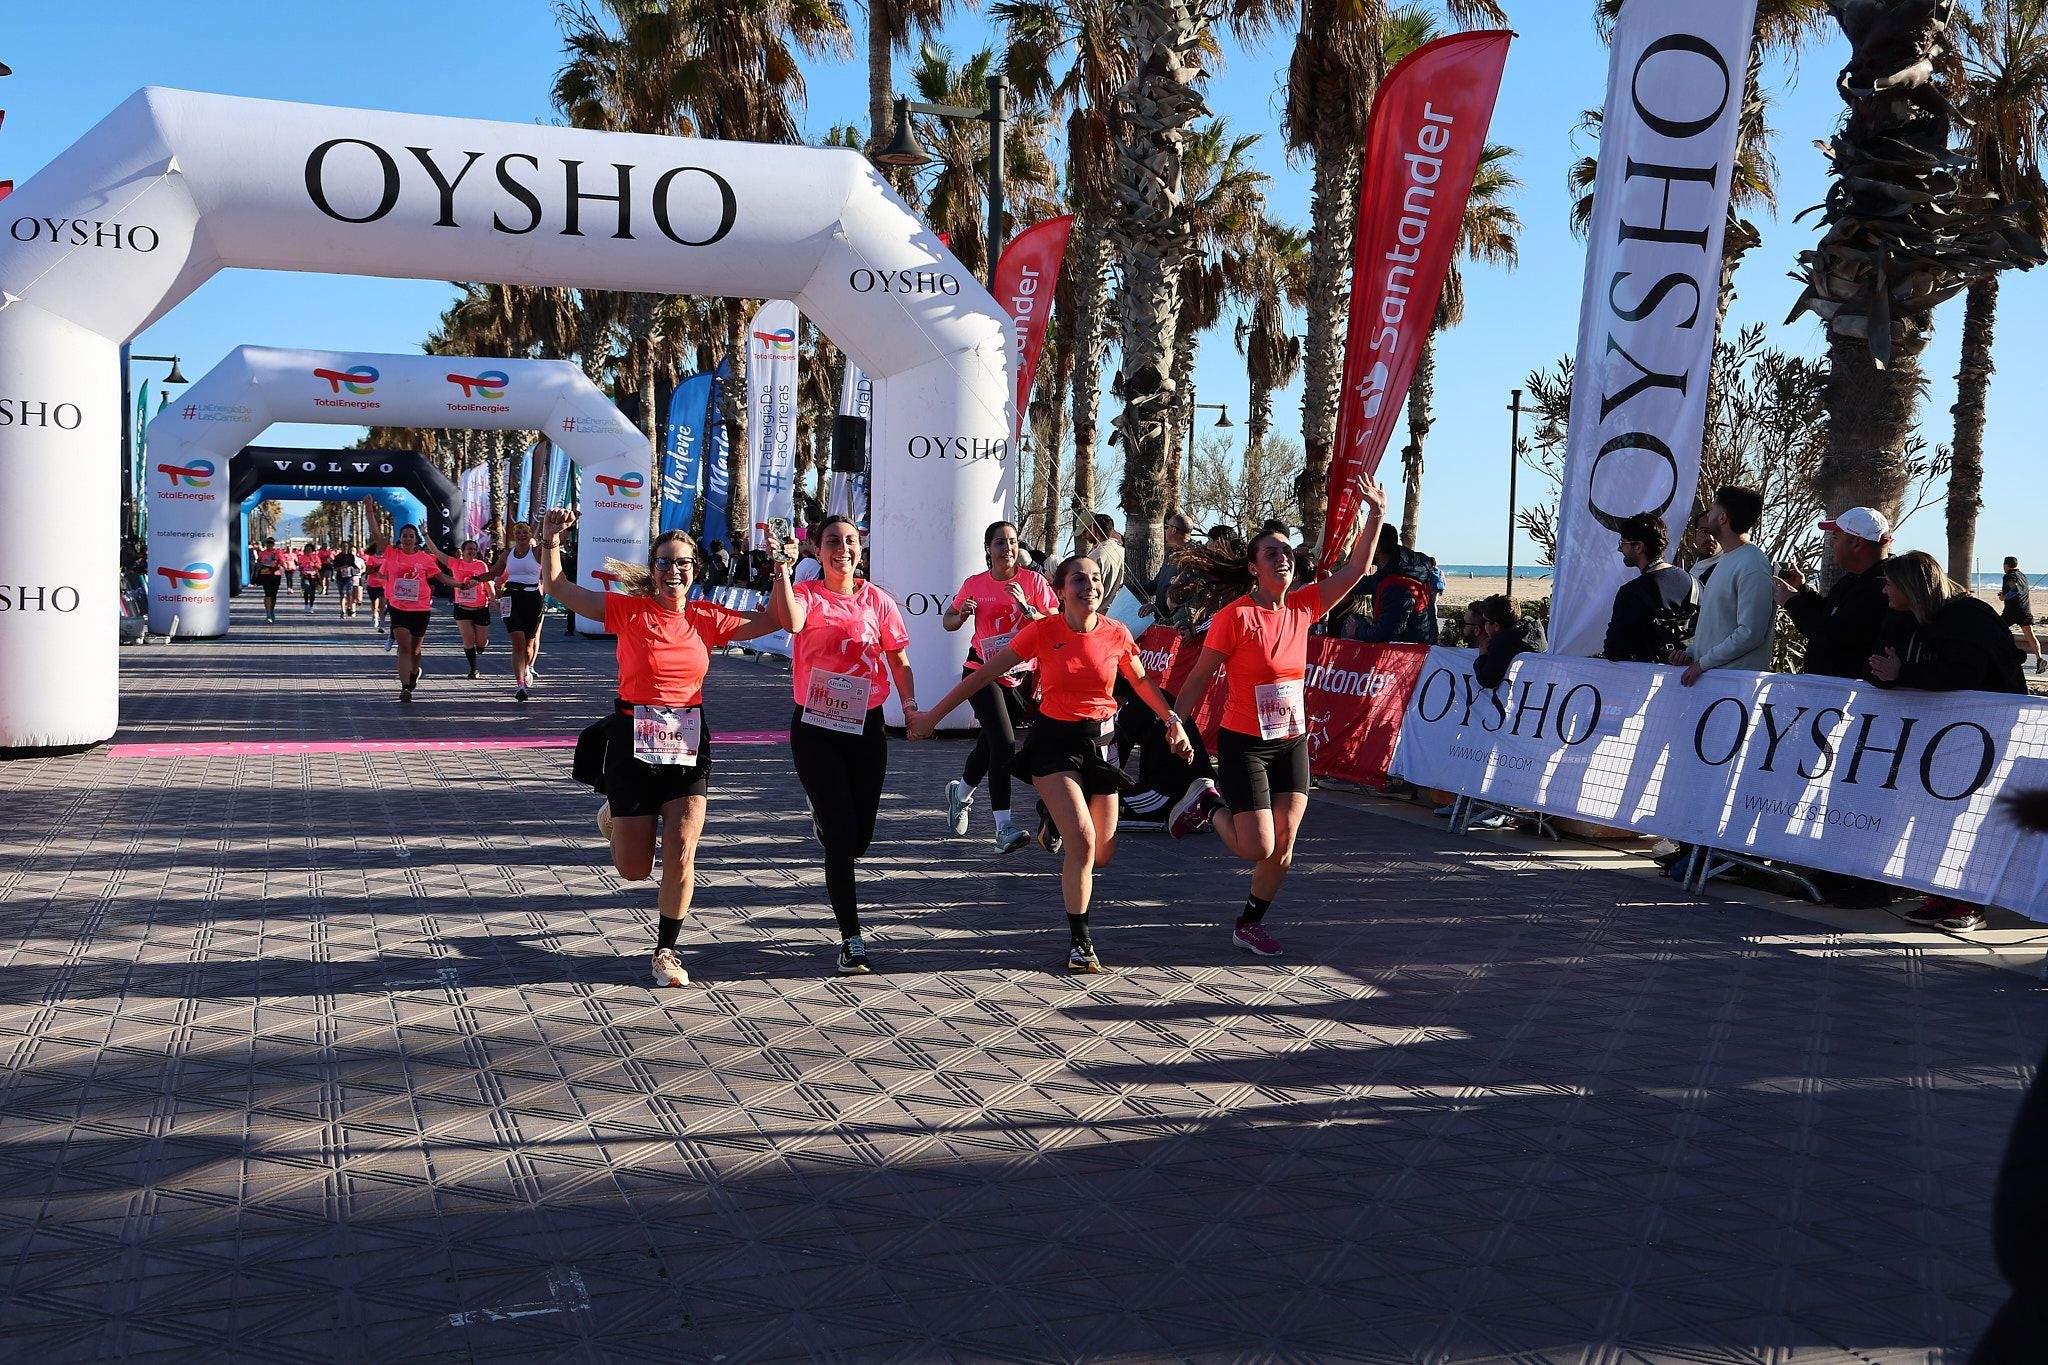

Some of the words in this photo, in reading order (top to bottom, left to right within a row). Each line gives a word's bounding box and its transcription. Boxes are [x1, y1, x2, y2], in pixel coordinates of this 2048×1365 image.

[305, 138, 737, 247] OYSHO
[11, 216, 159, 253] OYSHO
[1369, 102, 1453, 354] Santander
[850, 268, 960, 296] OYSHO
[1588, 33, 1730, 534] OYSHO
[1012, 265, 1039, 352] ander
[754, 353, 796, 362] TotalEnergies
[0, 399, 82, 430] SHO
[314, 398, 381, 410] TotalEnergies
[447, 403, 510, 414] TotalEnergies
[774, 385, 790, 468] LasCarreras
[908, 436, 1008, 461] OYSHO
[273, 460, 394, 473] VOLVO
[663, 426, 695, 504] Marlene
[157, 491, 215, 501] TotalEnergies
[594, 500, 643, 511] TotalEnergies
[157, 530, 215, 539] totalenergies.es
[0, 585, 80, 613] SHO
[157, 594, 215, 604] TotalEnergies
[1141, 646, 1174, 673] ander
[1304, 663, 1396, 698] antander
[826, 697, 849, 710] 016
[1418, 668, 1602, 746] OYSHO
[658, 731, 683, 741] 016
[1694, 697, 1996, 801] OYSHO
[1449, 745, 1534, 772] WWW.OYSHO.COM
[1744, 794, 1883, 833] WWW.OYSHO.COM
